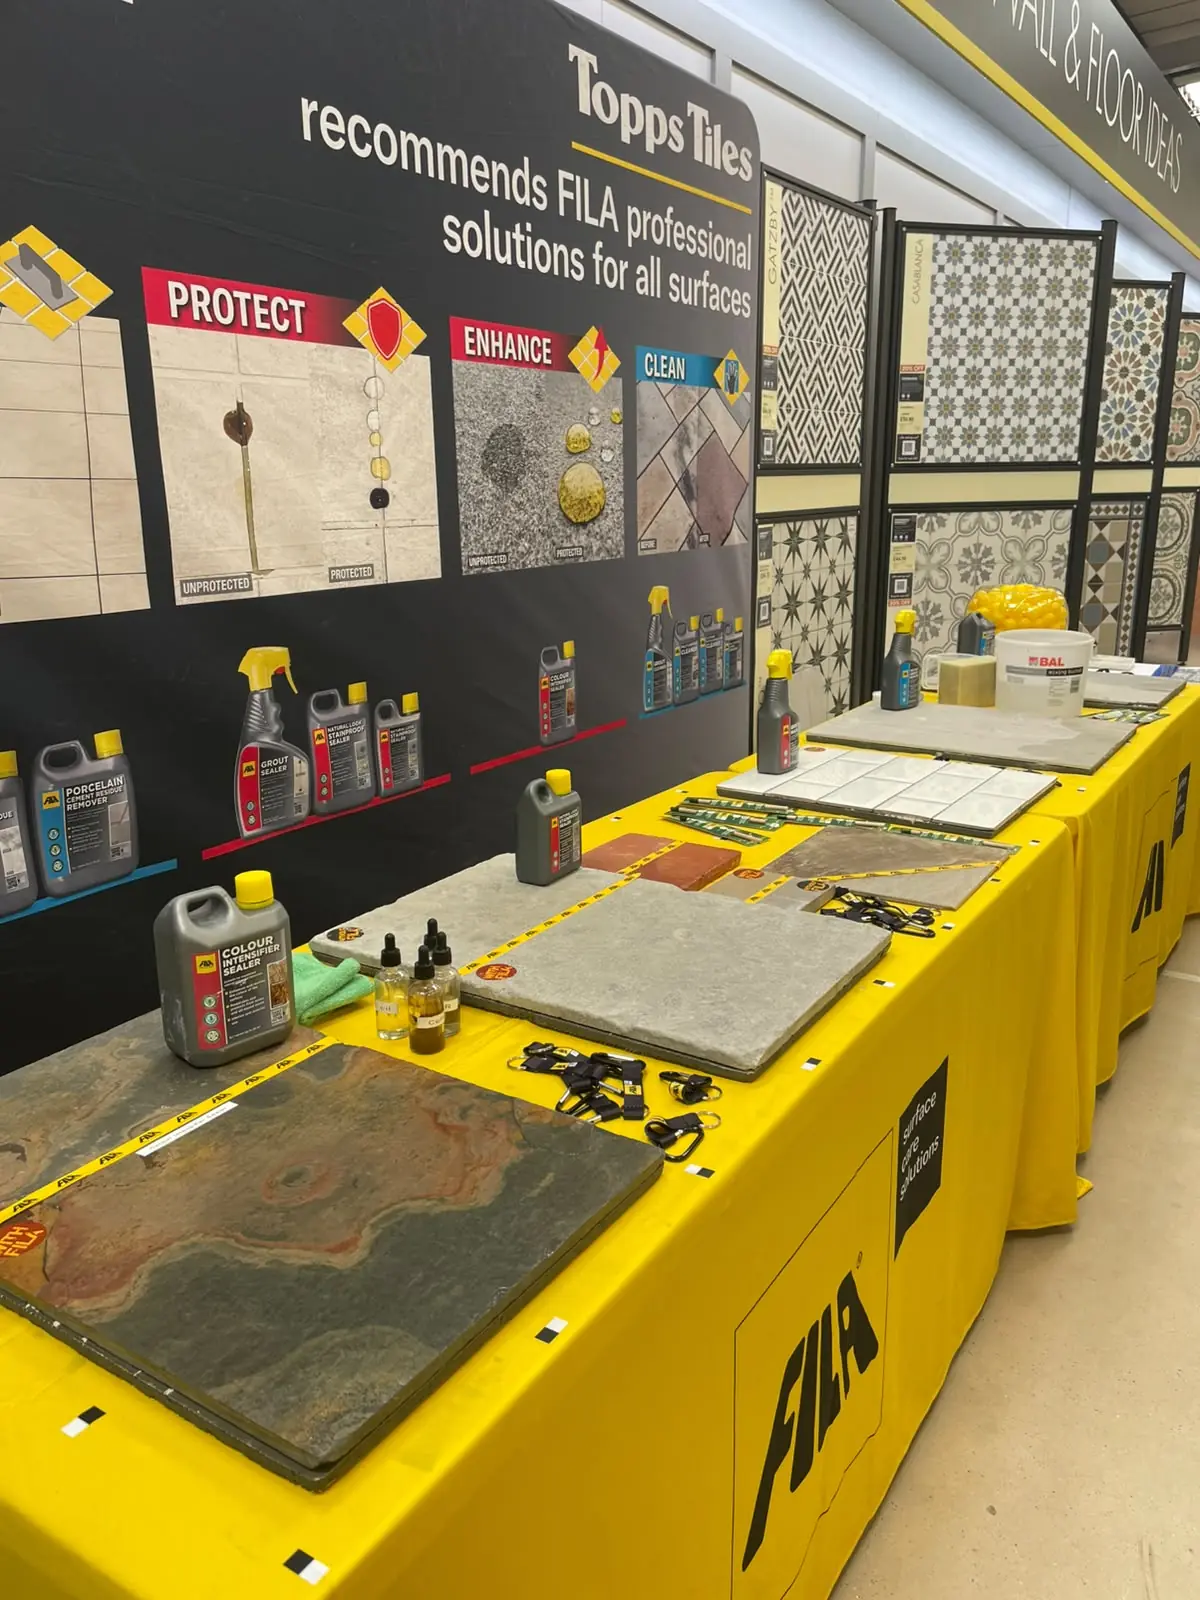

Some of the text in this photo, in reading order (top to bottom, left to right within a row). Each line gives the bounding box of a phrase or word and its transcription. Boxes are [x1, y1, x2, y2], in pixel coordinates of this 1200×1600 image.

[1064, 0, 1081, 91] &
[1086, 22, 1144, 156] FLOOR
[1145, 97, 1182, 193] IDEAS
[568, 43, 752, 182] Topps Tiles
[301, 97, 751, 271] recommends FILA professional
[768, 204, 777, 284] GATZBY
[443, 210, 751, 318] solutions for all surfaces
[912, 239, 924, 304] CASABLANCA
[168, 280, 305, 333] PROTECT
[464, 326, 552, 365] ENHANCE
[645, 353, 685, 380] CLEAN
[469, 555, 507, 567] UNPROTECTED
[557, 548, 583, 557] PROTECTED
[330, 566, 373, 580] PROTECTED
[182, 577, 250, 595] UNPROTECTED
[1040, 657, 1064, 666] BAL
[328, 725, 365, 740] STAINPROOF
[329, 736, 350, 747] SEALER
[260, 765, 287, 776] SEALER
[261, 756, 288, 768] GROUT
[66, 776, 124, 797] PORCELAIN
[66, 786, 122, 803] CEMENT RESIDUE
[67, 797, 108, 811] REMOVER
[222, 936, 273, 958] COLOUR
[223, 944, 280, 968] INTENSIFIER
[224, 958, 261, 976] SEALER
[903, 1092, 937, 1145] surface
[901, 1136, 920, 1173] care
[899, 1135, 940, 1201] solutions
[3, 1229, 44, 1257] FILA
[742, 1270, 879, 1572] FILA
